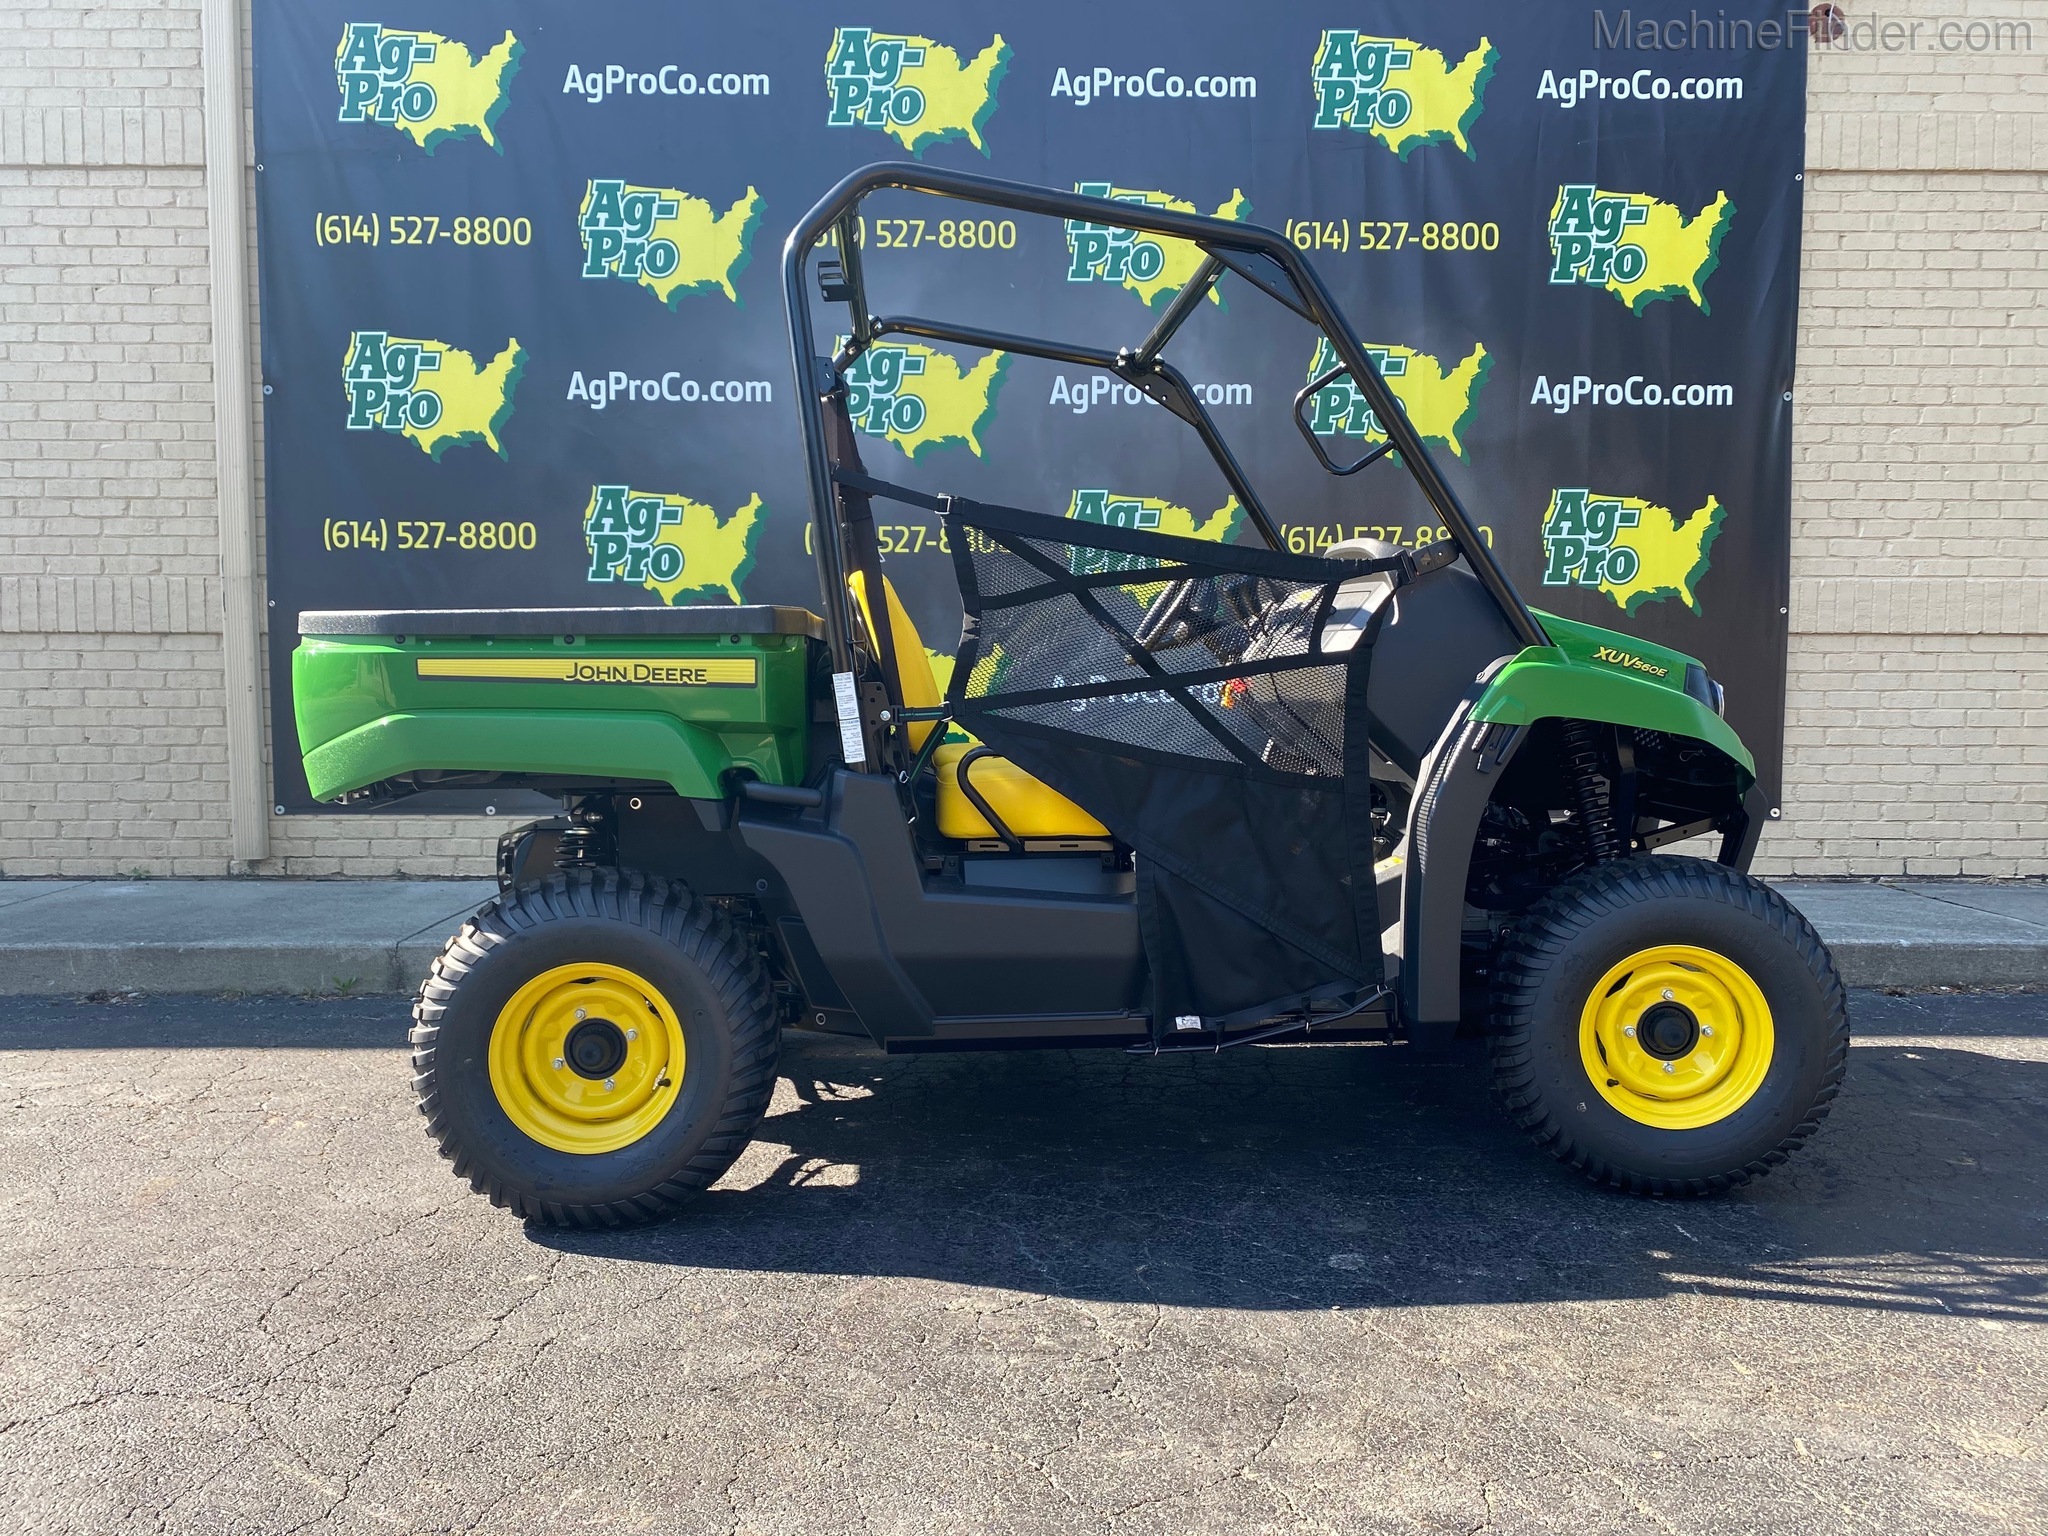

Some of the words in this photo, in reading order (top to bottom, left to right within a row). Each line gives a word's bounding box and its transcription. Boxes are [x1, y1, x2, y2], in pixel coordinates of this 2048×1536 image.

[340, 22, 437, 82] Ag-
[828, 27, 925, 86] Ag-
[1316, 29, 1412, 88] Ag-
[337, 73, 437, 122] Pro
[562, 64, 770, 104] AgProCo.com
[825, 77, 926, 127] Pro
[1051, 67, 1257, 107] AgProCo.com
[1312, 79, 1412, 130] Pro
[1537, 69, 1743, 109] AgProCo.com
[315, 213, 380, 246] (614)
[390, 216, 532, 245] 527-8800
[583, 179, 679, 239] Ag-
[1553, 184, 1648, 244] Ag-
[581, 229, 679, 279] Pro
[876, 219, 1017, 249] 527-8800
[1067, 232, 1164, 281] Pro
[1285, 219, 1350, 252] (614)
[1359, 222, 1500, 251] 527-8800
[1548, 234, 1647, 284] Pro
[345, 331, 442, 390] Ag-
[345, 381, 443, 431] Pro
[567, 371, 772, 410] AgProCo.com
[1531, 375, 1733, 414] AgProCo.com
[323, 517, 389, 551] (614)
[397, 521, 537, 550] 527-8800
[586, 485, 683, 544] Ag-
[1547, 488, 1640, 547] Ag-
[586, 533, 683, 582] Pro
[1542, 537, 1638, 587] Pro
[565, 662, 628, 681] JOHN
[633, 664, 708, 683] DEERE
[1592, 645, 1669, 678] XUV560E
